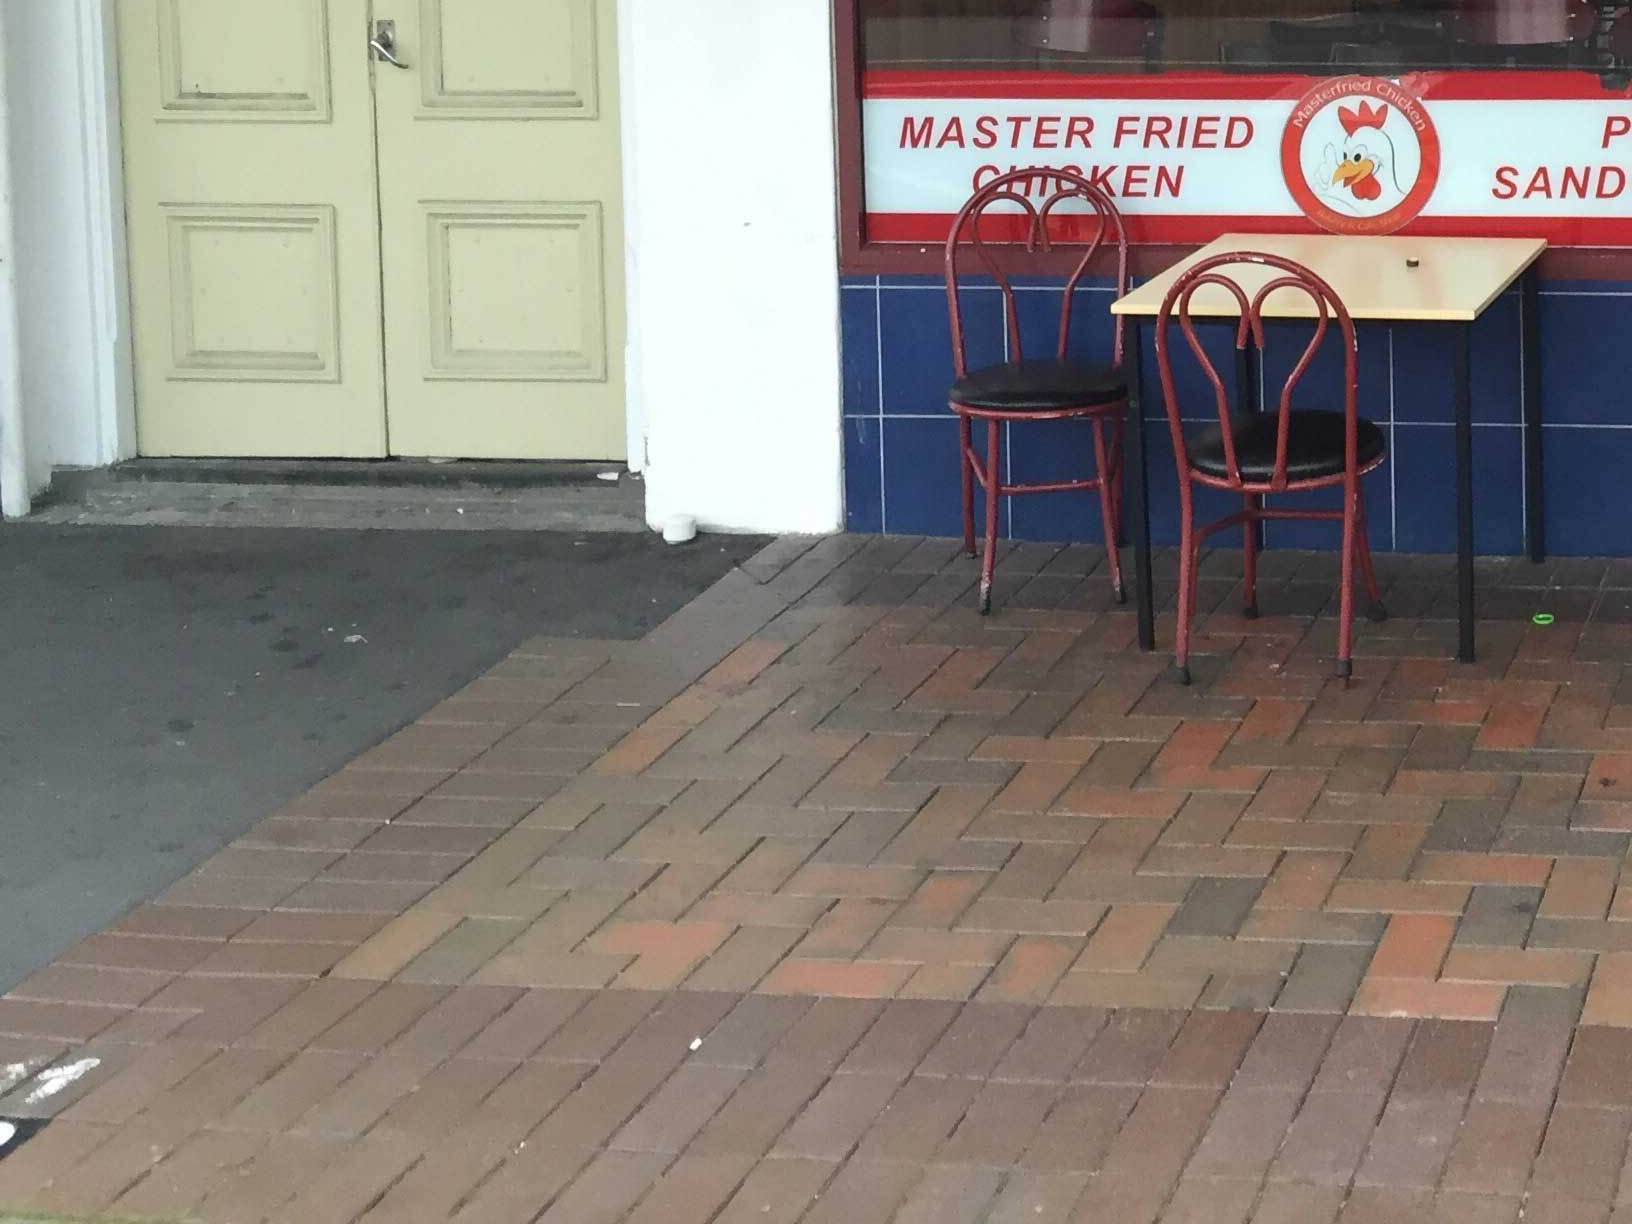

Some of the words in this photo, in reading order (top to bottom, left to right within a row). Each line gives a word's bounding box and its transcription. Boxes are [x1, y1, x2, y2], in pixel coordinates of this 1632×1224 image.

[1293, 81, 1371, 128] Masterfried
[1376, 83, 1426, 132] Chicken
[900, 116, 1095, 149] MASTER
[1114, 116, 1255, 149] FRIED
